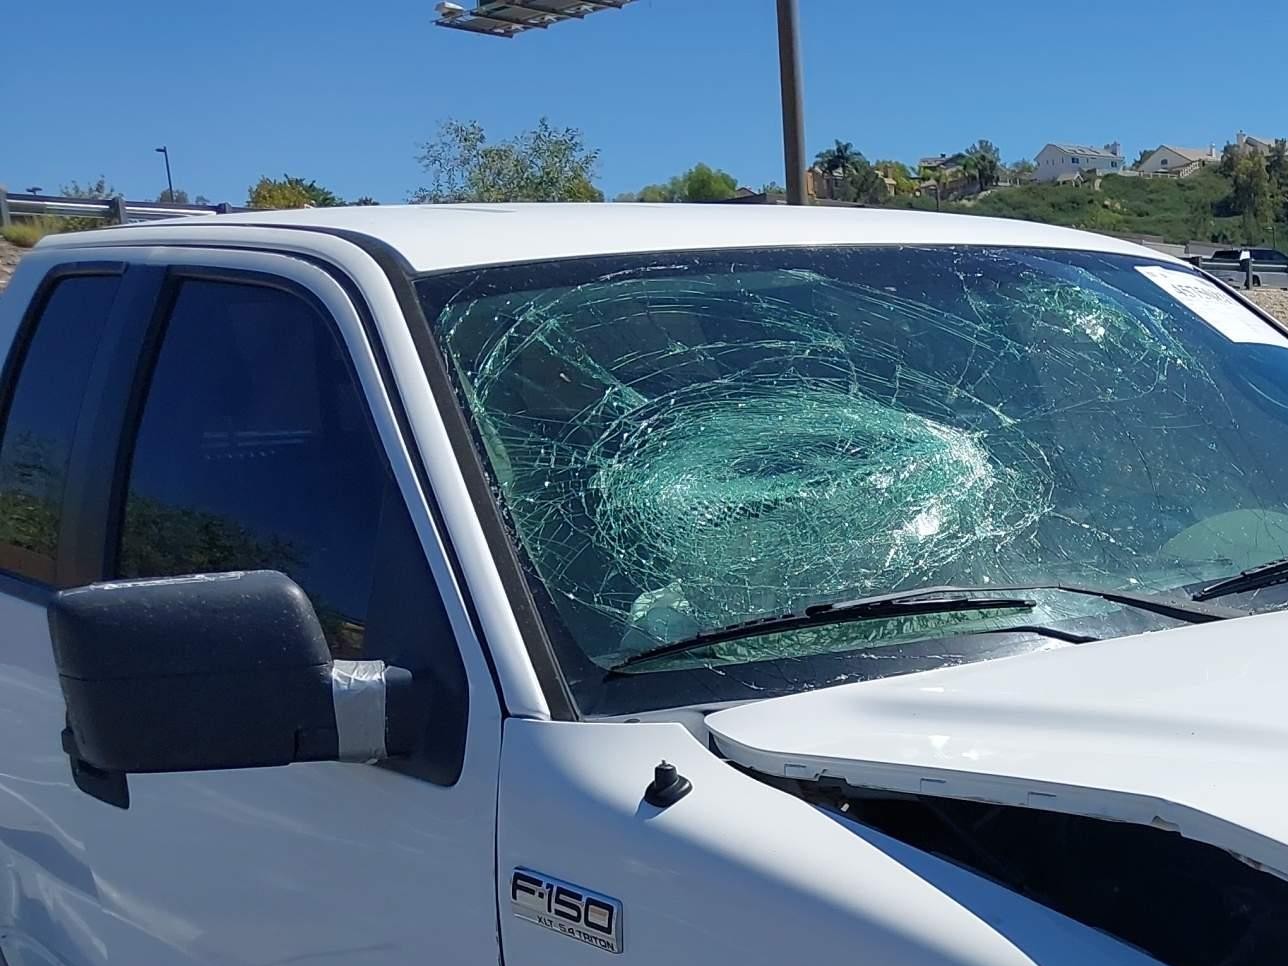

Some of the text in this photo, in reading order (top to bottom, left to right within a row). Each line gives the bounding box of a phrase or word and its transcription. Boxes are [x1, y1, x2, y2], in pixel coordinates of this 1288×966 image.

[512, 872, 614, 935] F-150
[537, 915, 554, 929] XLT
[576, 930, 616, 951] TRITON
